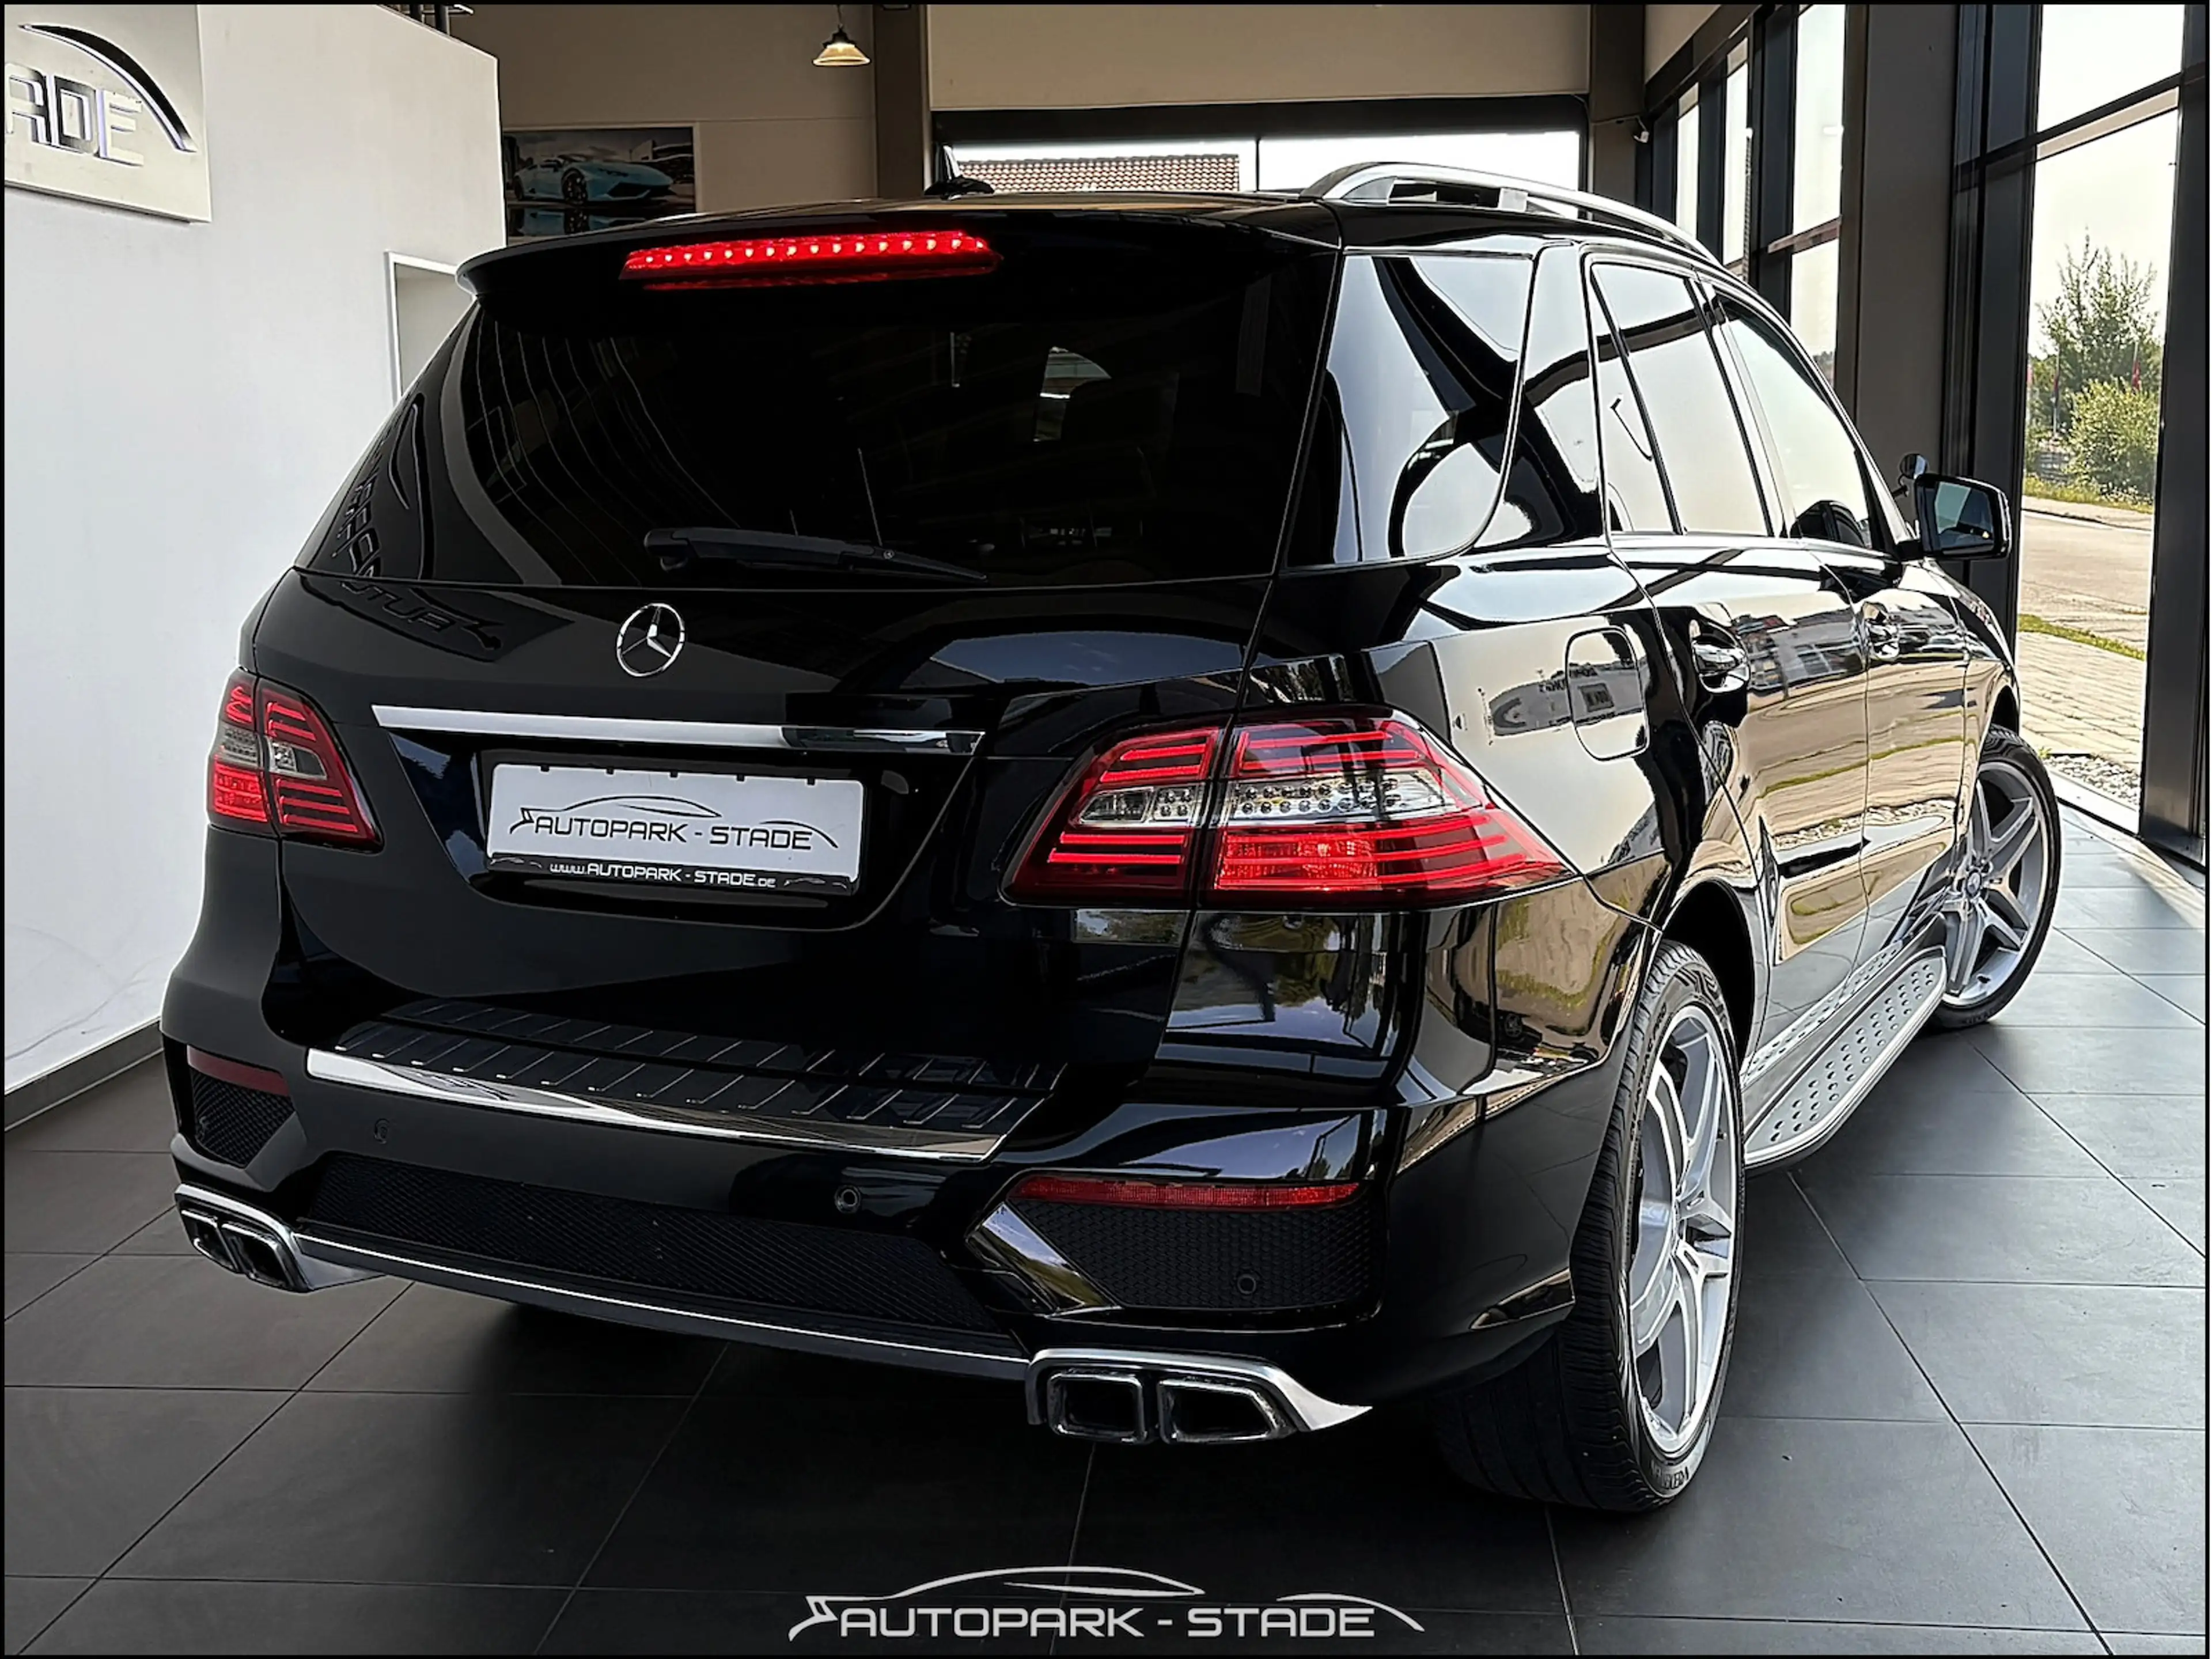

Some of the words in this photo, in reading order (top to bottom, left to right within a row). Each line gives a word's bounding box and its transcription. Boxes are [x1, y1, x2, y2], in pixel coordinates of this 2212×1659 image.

[535, 816, 688, 843] AUTOPARK
[709, 826, 813, 850] STADE
[550, 862, 682, 882] www.AUTOPARK
